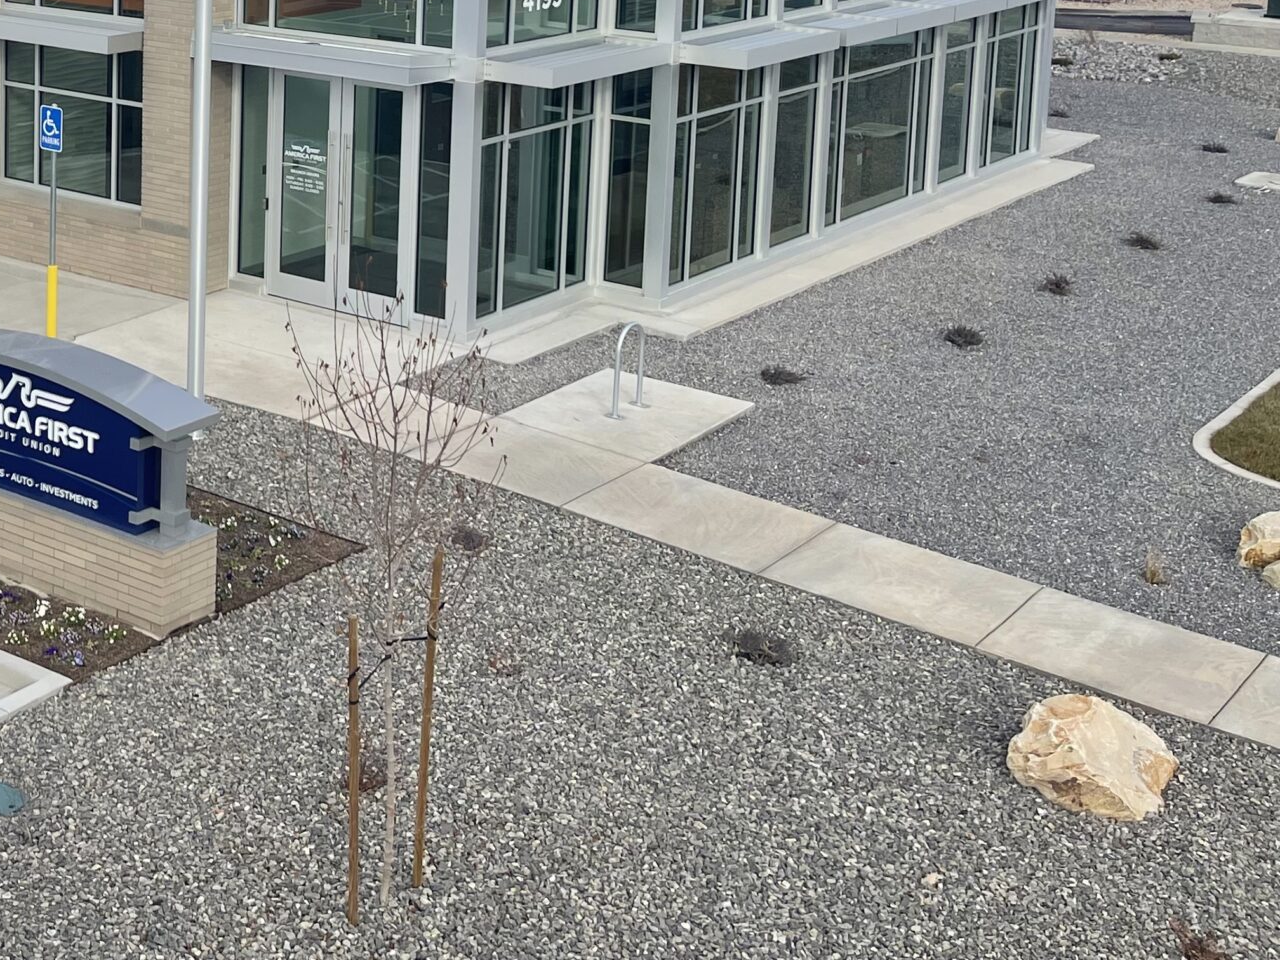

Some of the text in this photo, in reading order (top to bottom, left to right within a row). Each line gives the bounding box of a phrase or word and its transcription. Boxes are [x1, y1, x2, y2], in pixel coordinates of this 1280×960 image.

[42, 135, 60, 146] PARKING
[284, 149, 310, 160] AMERICA
[310, 154, 327, 162] FIRST
[34, 415, 100, 454] FIRST
[22, 437, 61, 457] UNION
[10, 472, 34, 487] AUTO
[40, 482, 99, 510] INVESTMENTS
